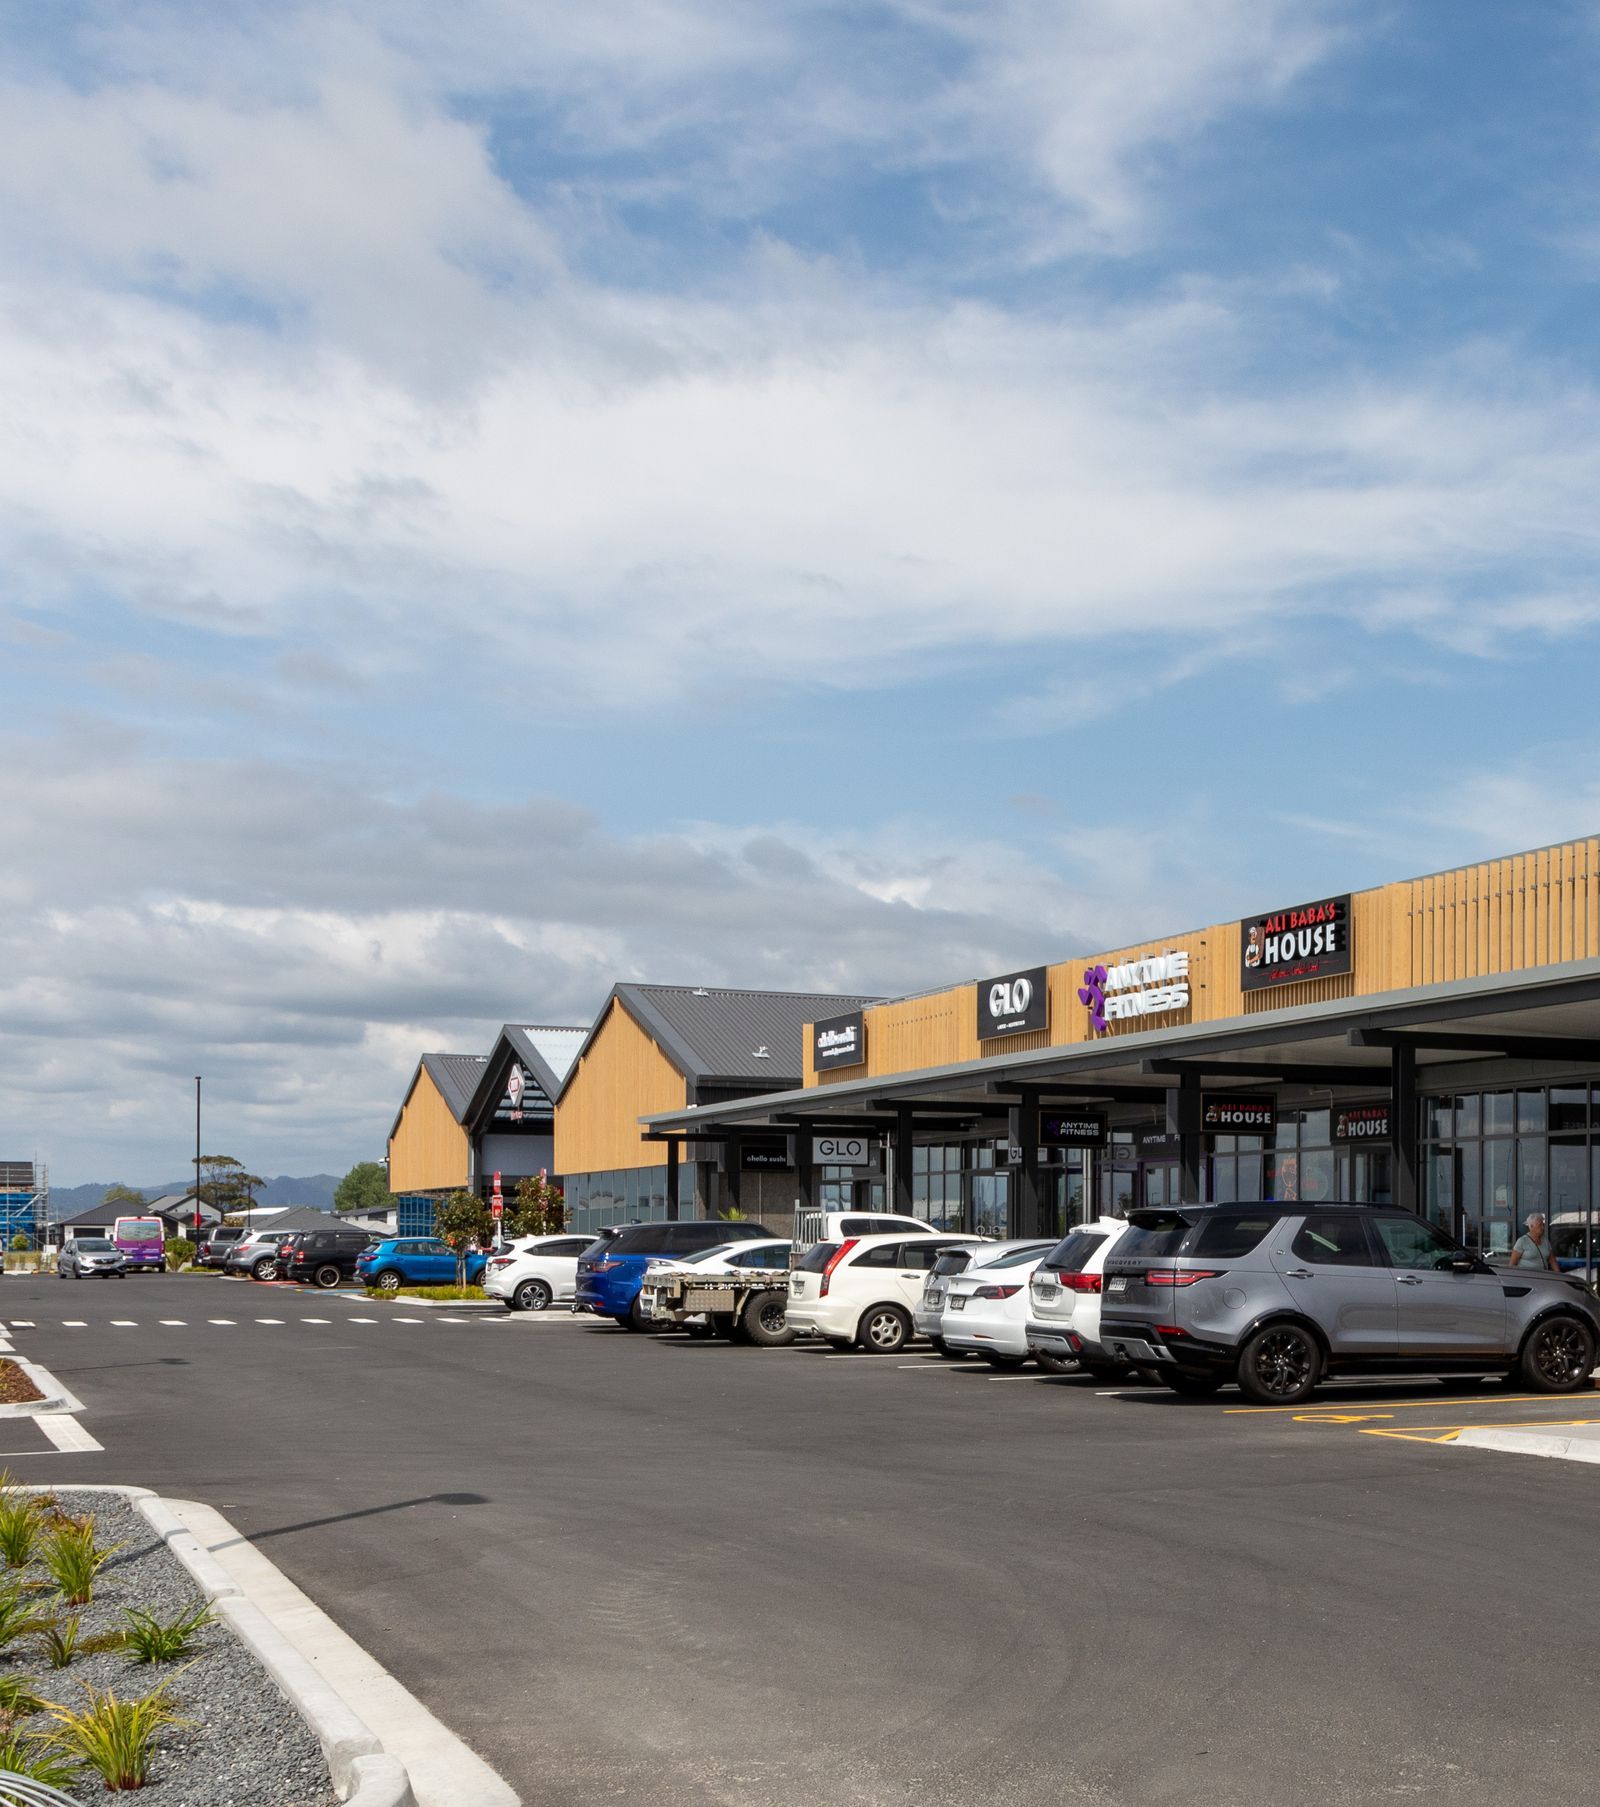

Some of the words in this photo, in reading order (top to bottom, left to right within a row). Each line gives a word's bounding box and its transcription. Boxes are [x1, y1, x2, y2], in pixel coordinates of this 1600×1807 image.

[1265, 914, 1286, 934] ALI
[1290, 902, 1336, 929] BABA'S
[1265, 922, 1336, 965] HOUSE
[1105, 951, 1189, 993] ANYTIME
[989, 978, 1033, 1017] GLO
[1104, 982, 1189, 1021] FITNESS
[1221, 1111, 1272, 1124] HOUSE
[1348, 1119, 1388, 1137] HOUSE
[819, 1140, 862, 1156] GLO
[1142, 1134, 1166, 1144] ANYTIME
